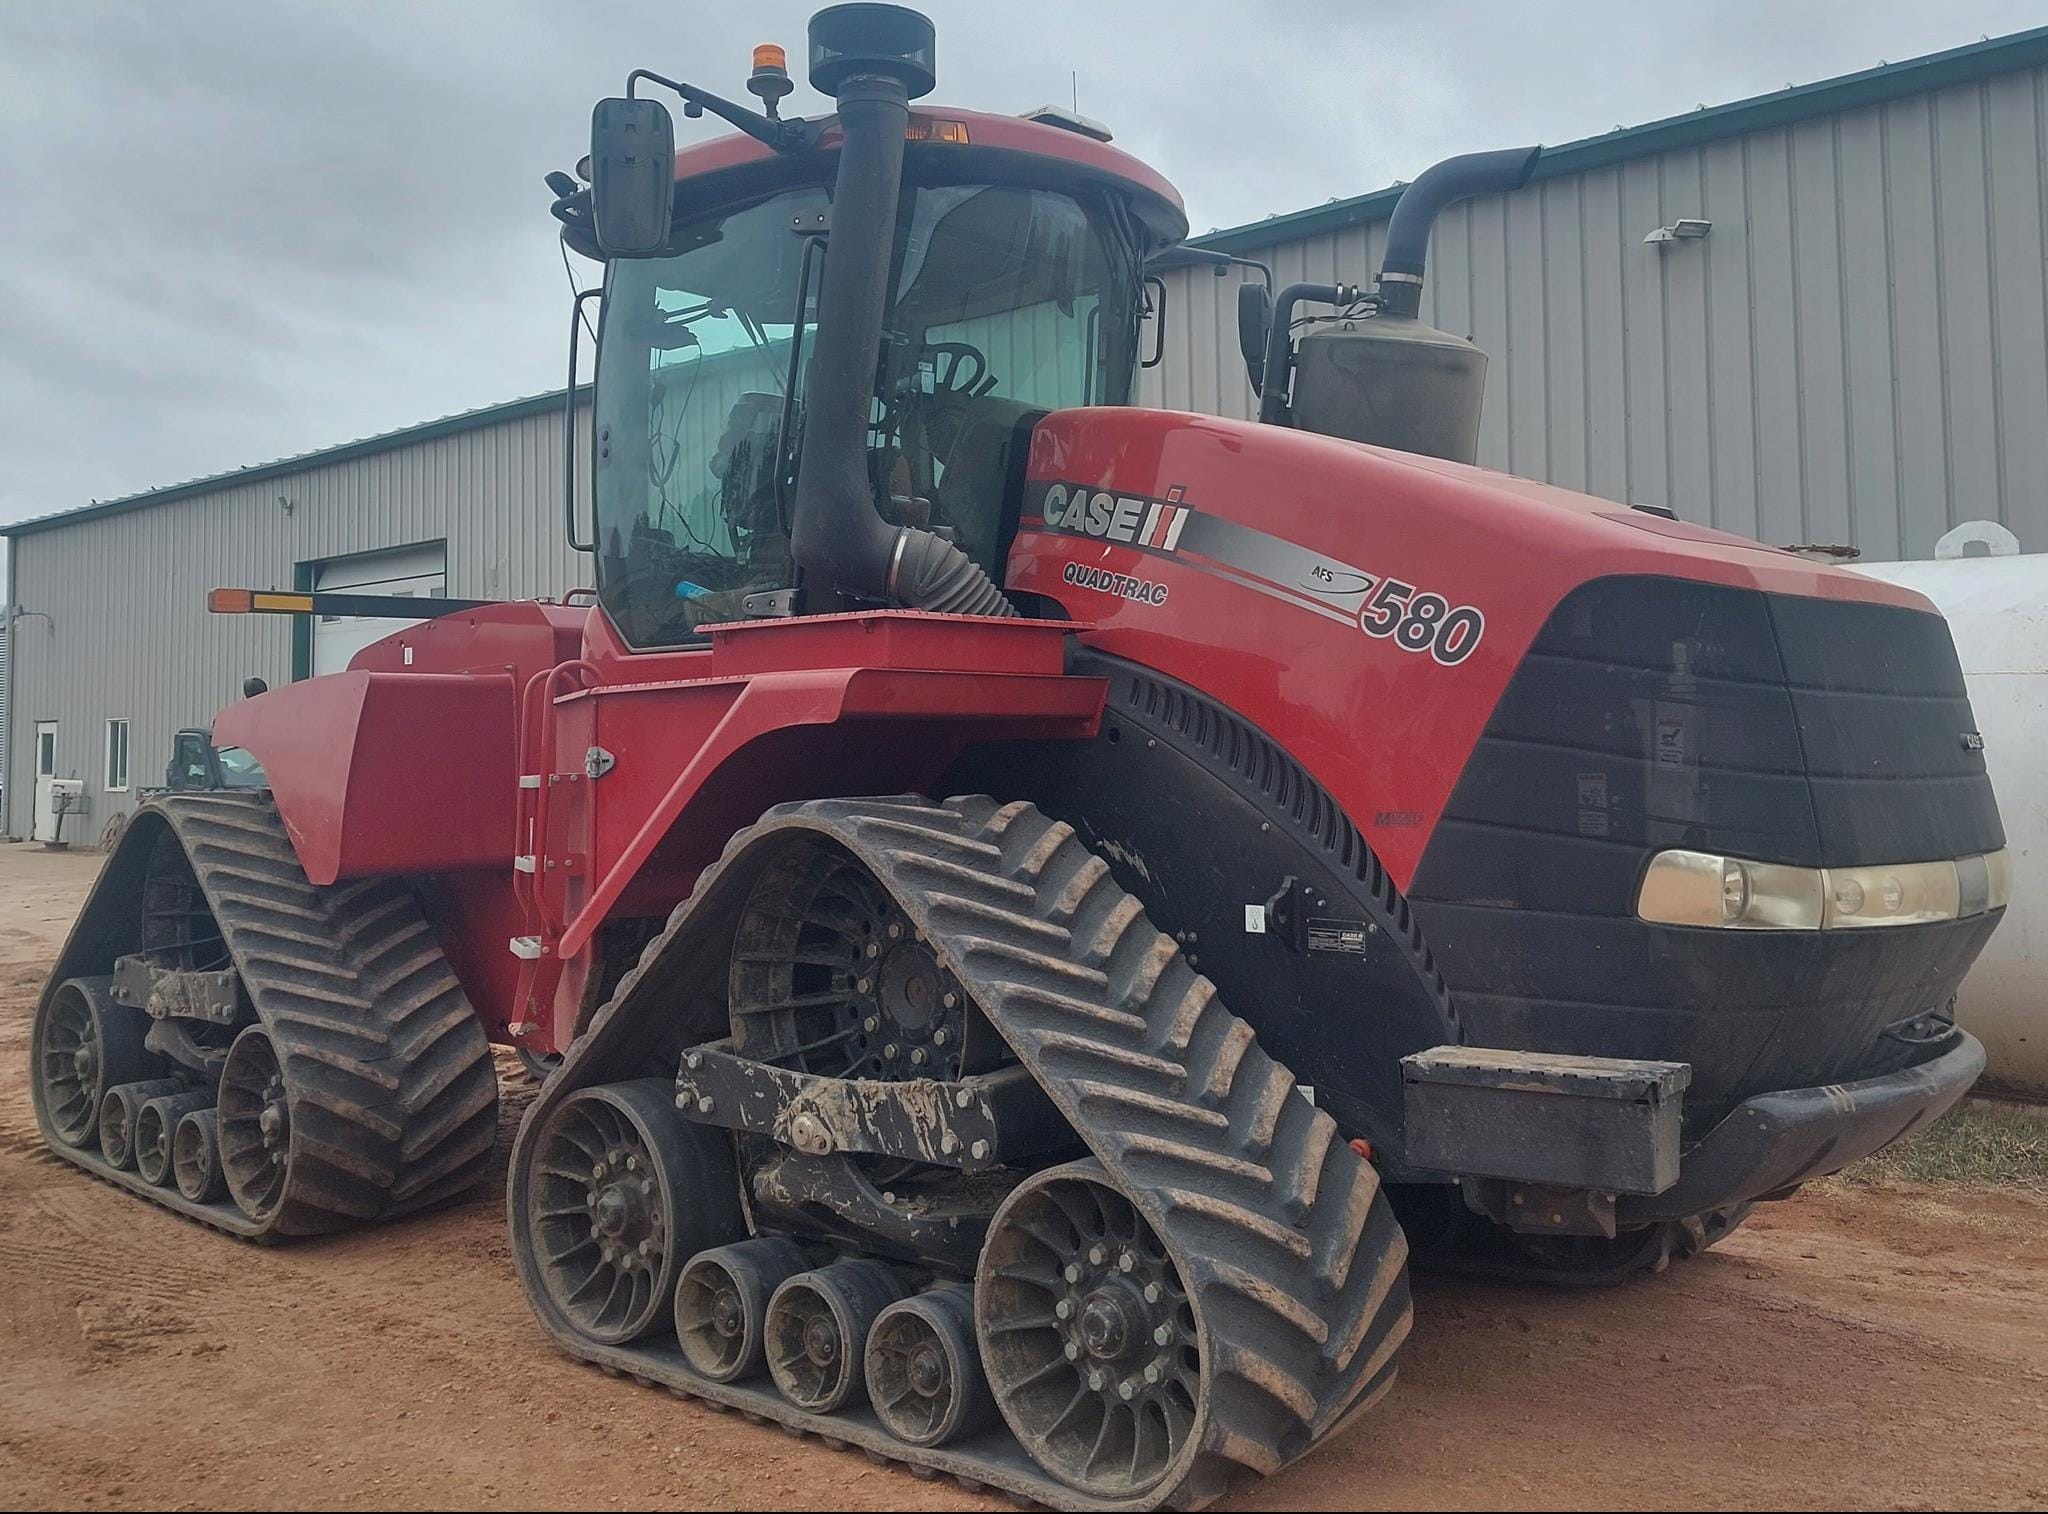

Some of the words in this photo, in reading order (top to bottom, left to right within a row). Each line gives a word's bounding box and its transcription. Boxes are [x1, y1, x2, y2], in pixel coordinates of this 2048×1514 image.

[1063, 561, 1168, 607] QUADTRAC
[1311, 565, 1334, 583] AFS
[1361, 577, 1485, 666] 580
